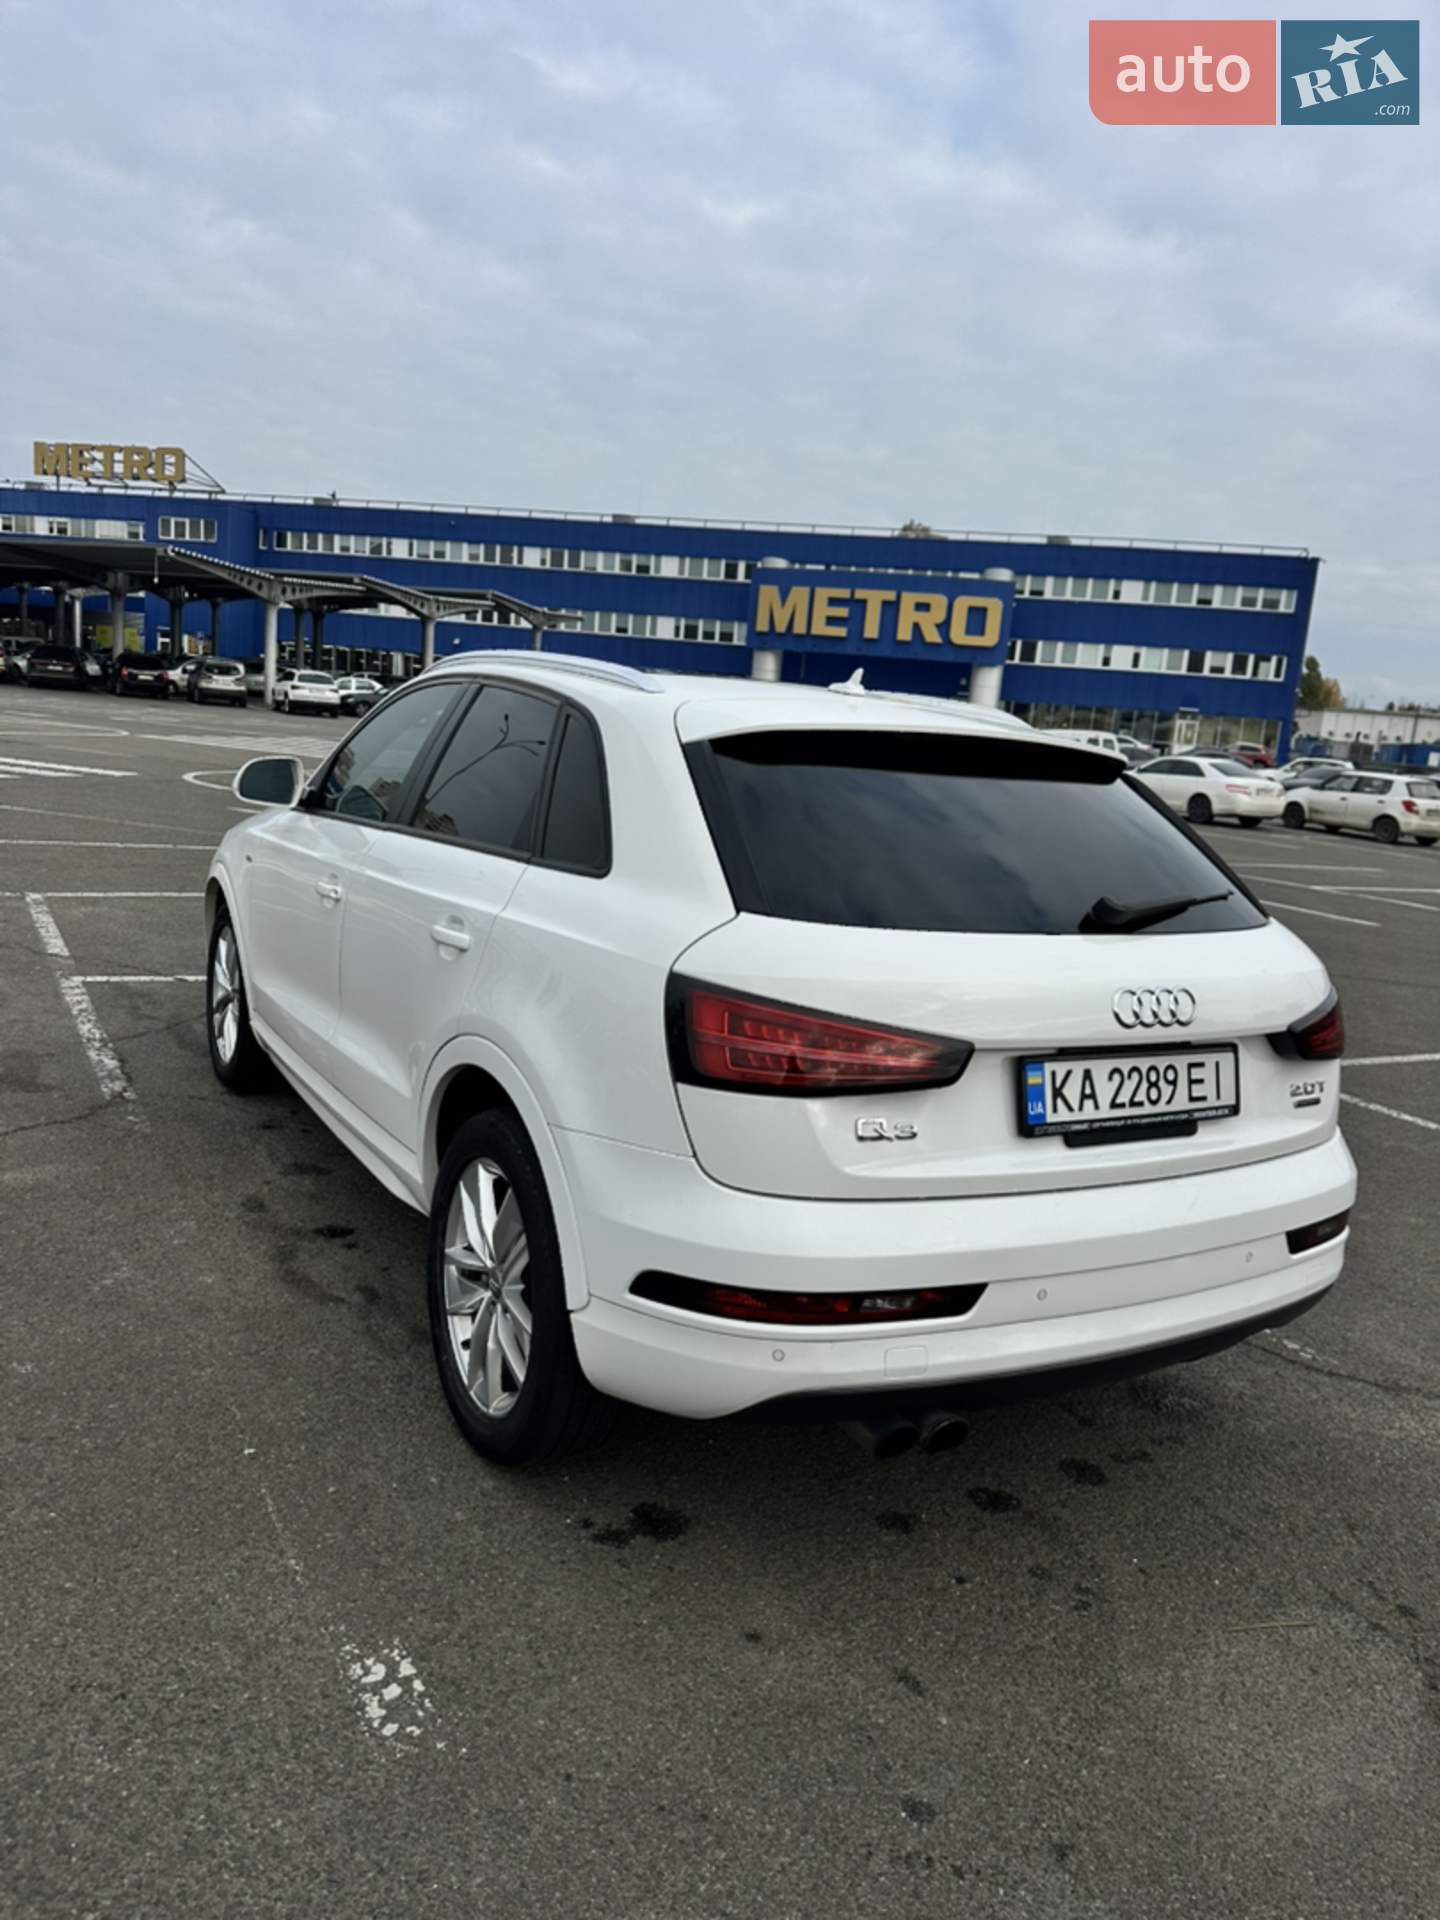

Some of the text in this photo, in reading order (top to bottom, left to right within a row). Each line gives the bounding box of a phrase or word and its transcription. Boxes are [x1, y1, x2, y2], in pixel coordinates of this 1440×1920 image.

[33, 441, 186, 483] METRO
[755, 584, 1004, 648] METRO
[1028, 1101, 1045, 1115] UA
[1051, 1061, 1221, 1114] KA 2289 EI
